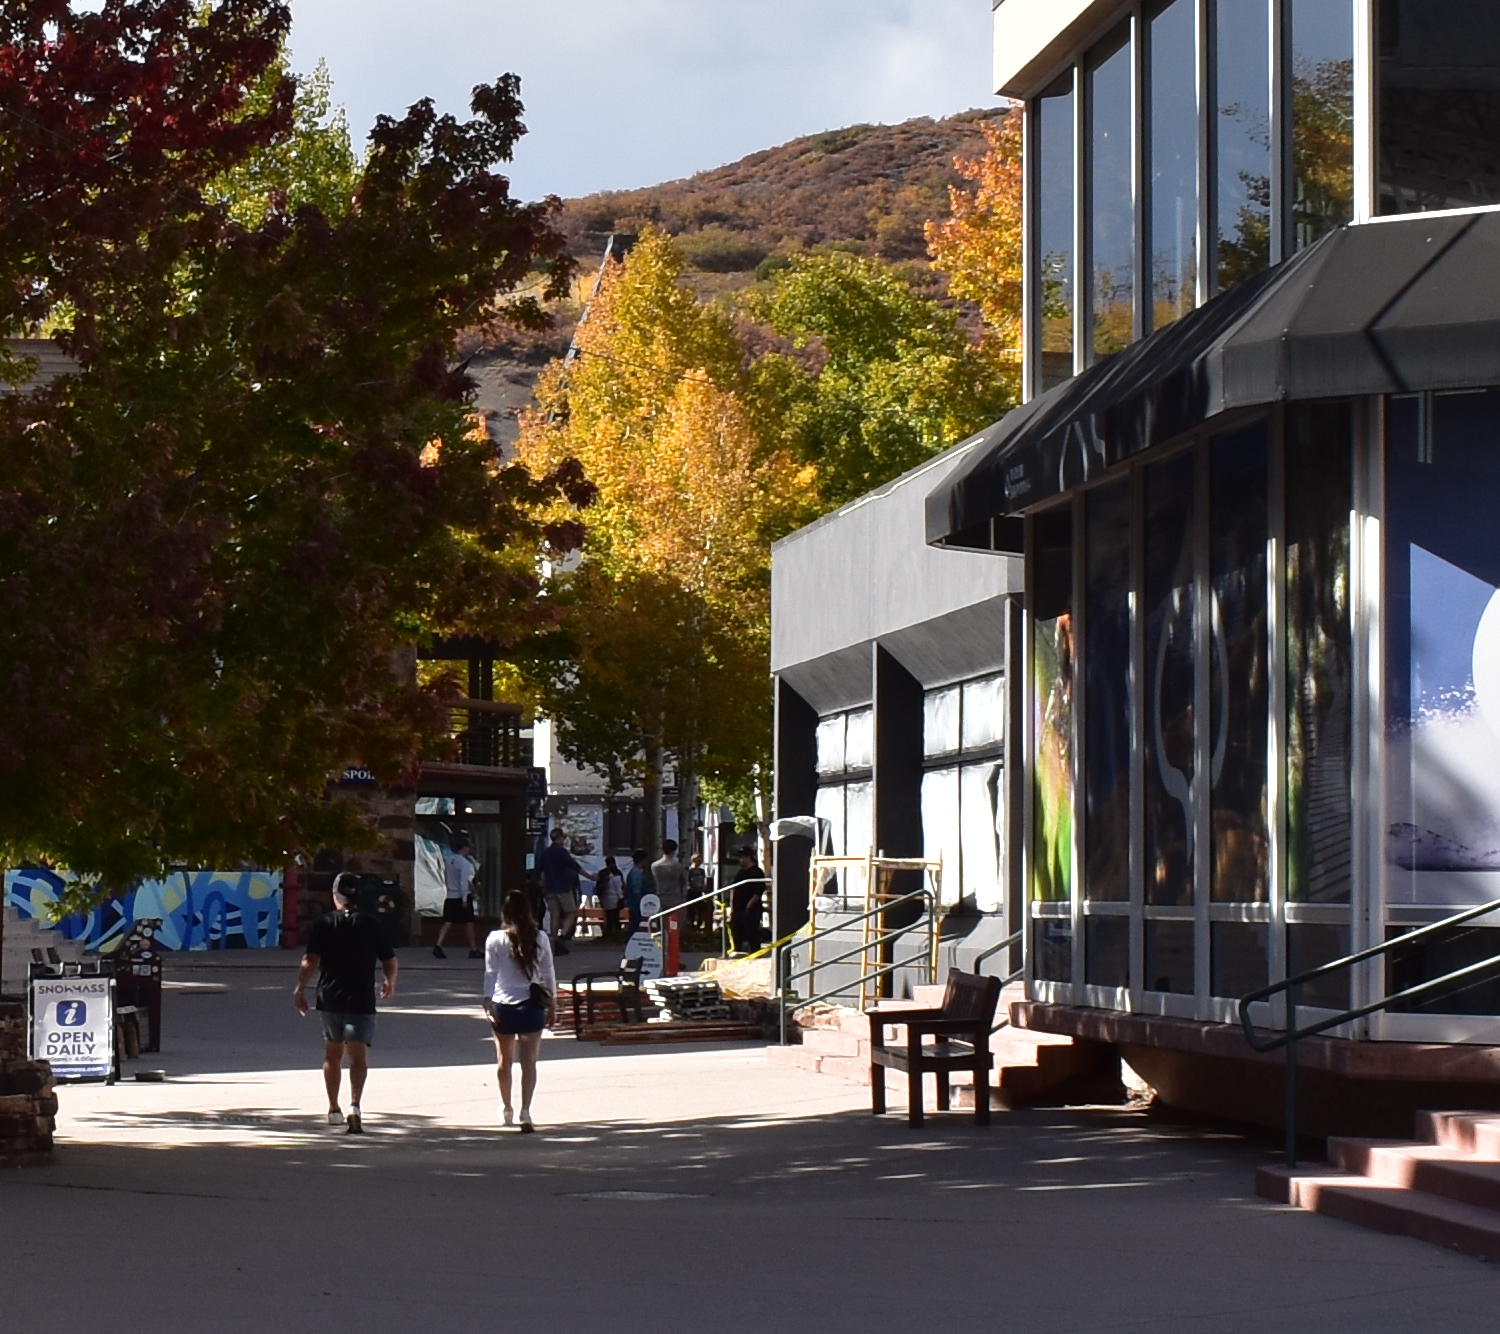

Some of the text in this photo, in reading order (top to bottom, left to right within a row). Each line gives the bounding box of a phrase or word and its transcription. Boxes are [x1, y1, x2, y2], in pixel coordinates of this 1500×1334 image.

[38, 984, 105, 995] SNOWMASS
[48, 1032, 94, 1043] OPEN
[46, 1044, 97, 1056] DAILY
